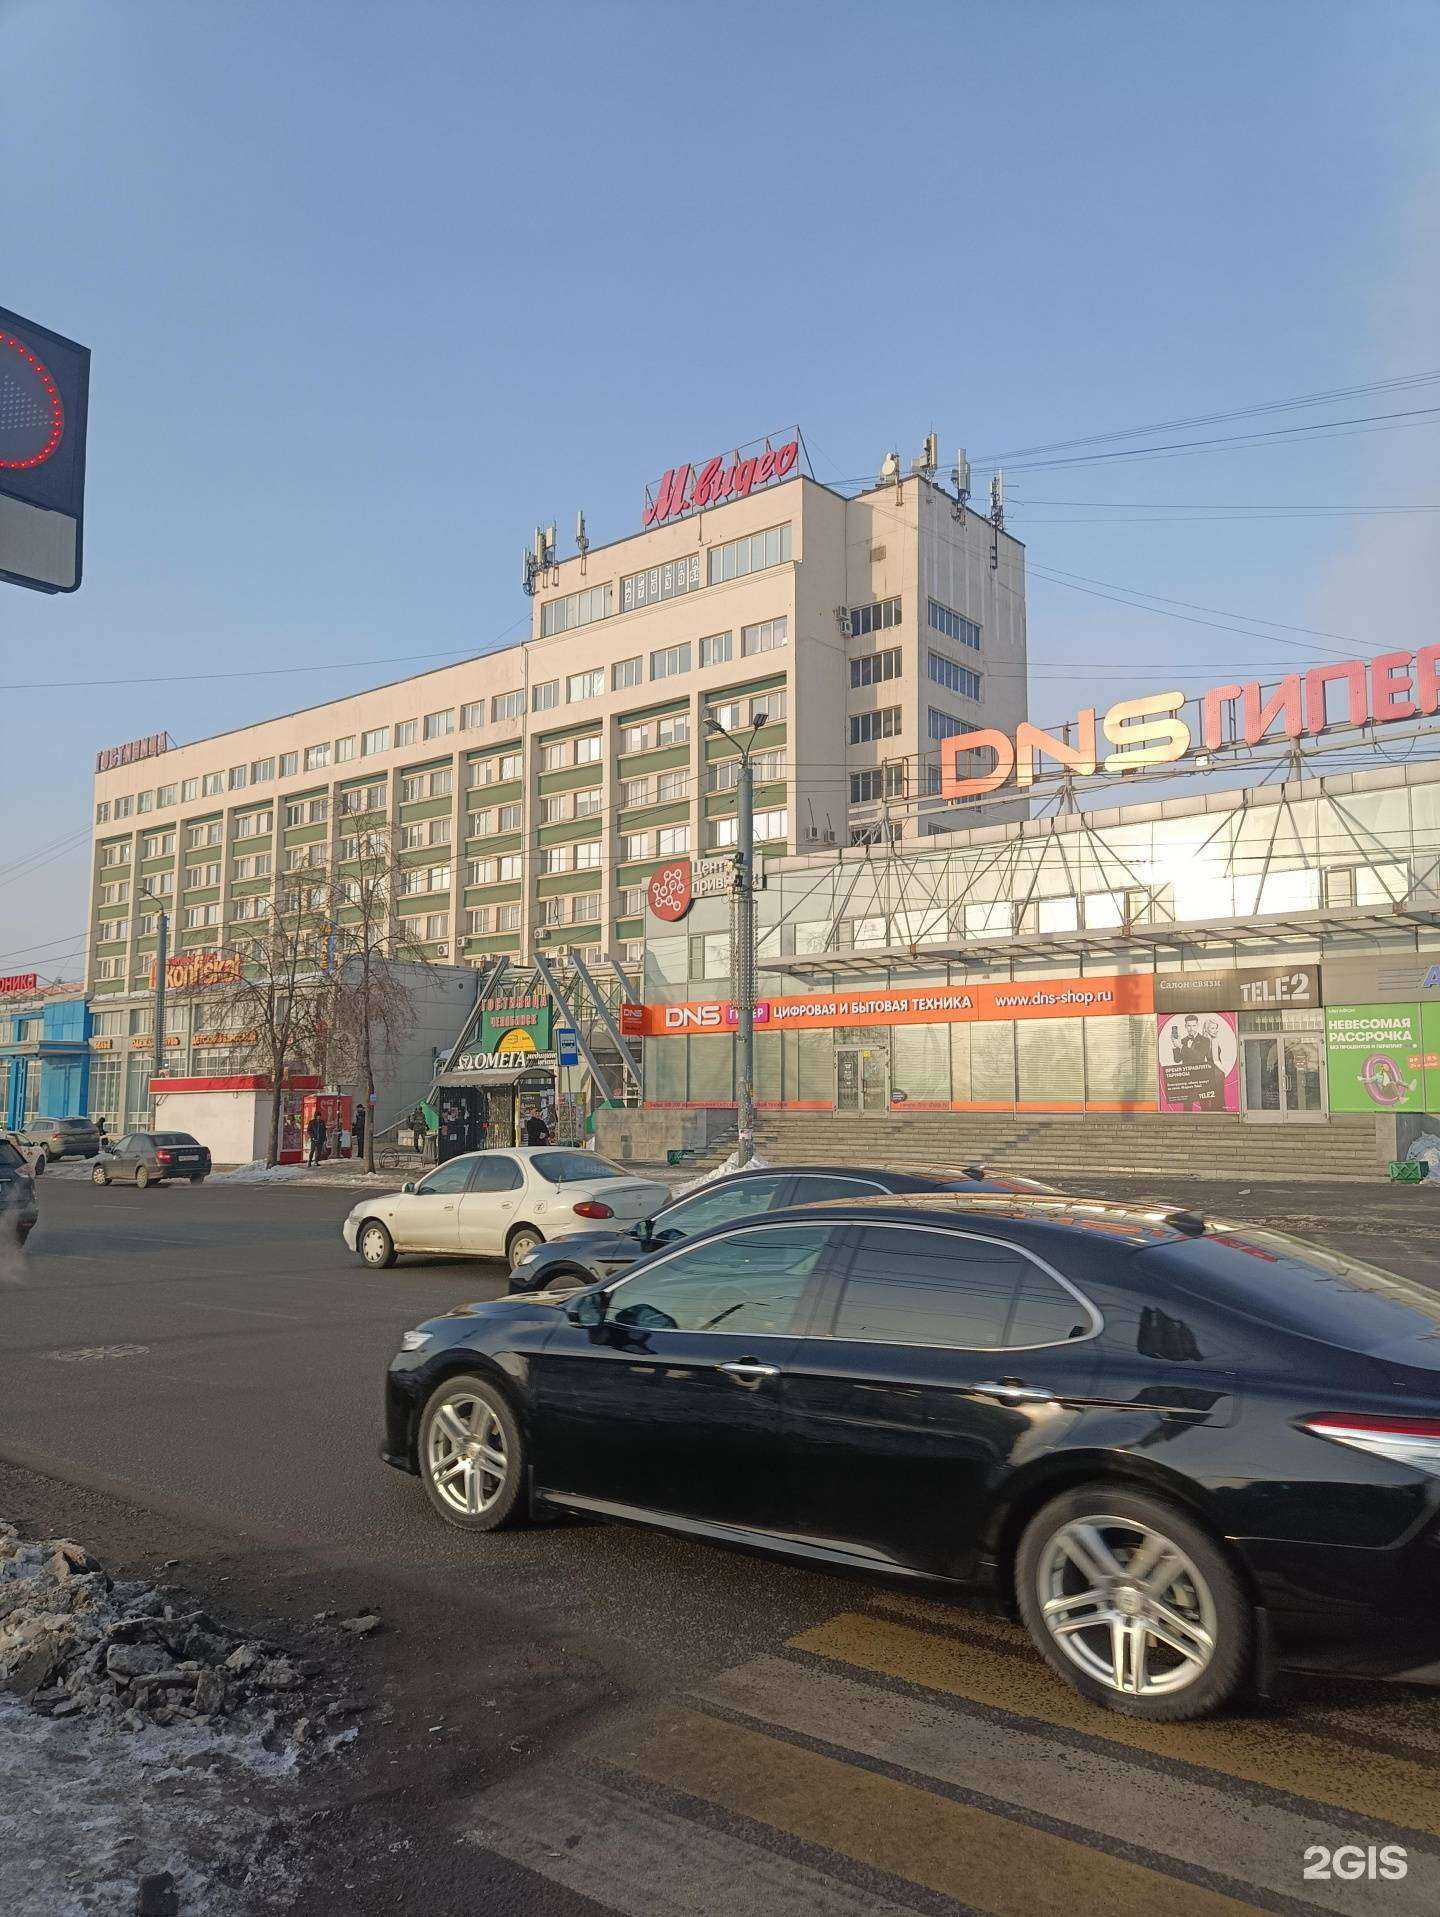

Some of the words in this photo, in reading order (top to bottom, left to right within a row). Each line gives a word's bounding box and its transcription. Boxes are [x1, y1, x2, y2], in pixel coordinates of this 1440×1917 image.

[643, 441, 798, 526] М.видео
[941, 690, 1191, 800] DNS
[693, 859, 738, 878] Цент
[1160, 980, 1190, 989] Салон
[1192, 979, 1221, 989] связи
[1240, 972, 1310, 1002] TELE2
[480, 994, 547, 1012] ГОСТИНИЦА
[773, 1003, 837, 1019] ЦИФРОВАЯ
[840, 1002, 849, 1014] И
[851, 999, 908, 1014] БЫТОВАЯ
[912, 995, 973, 1011] ТЕХНИКА
[995, 990, 1113, 1007] www.dns-shop.ru
[623, 1008, 643, 1017] DNS
[665, 1005, 721, 1028] DNS
[1328, 1017, 1411, 1030] НЕВЕСОМАЯ
[1329, 1030, 1412, 1042] РАССРОЧКА
[474, 1051, 526, 1069] ОМЕГА
